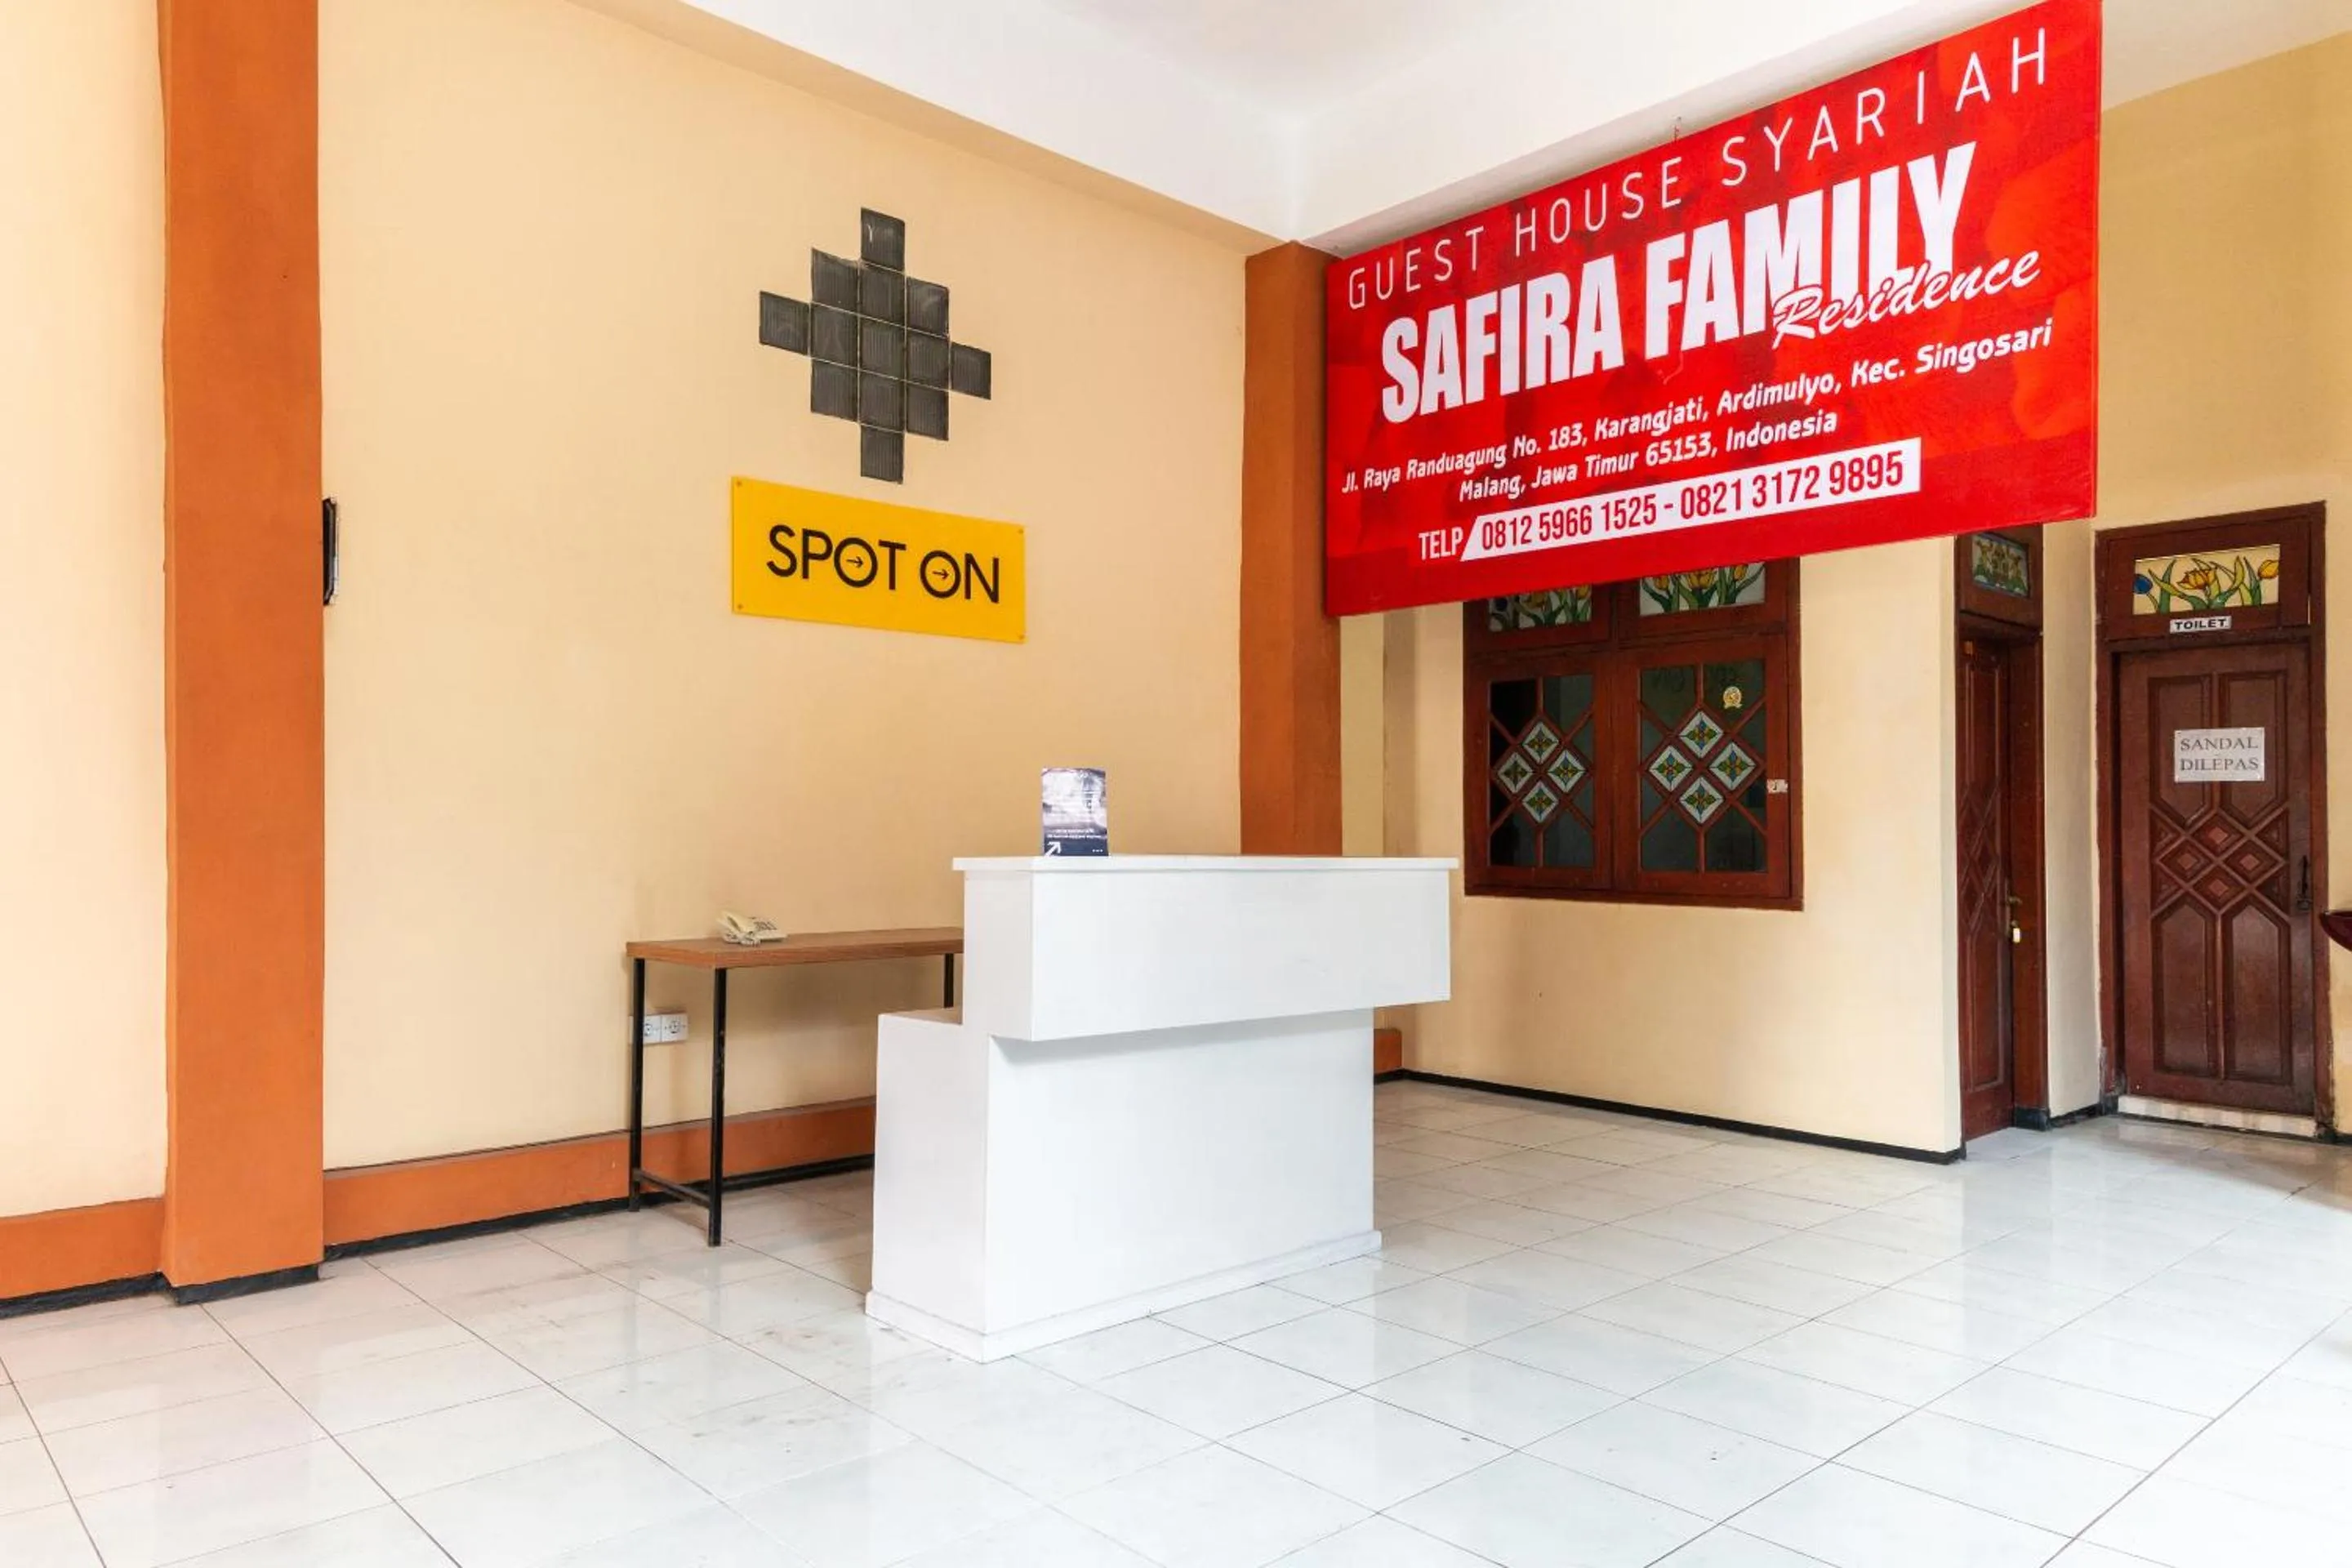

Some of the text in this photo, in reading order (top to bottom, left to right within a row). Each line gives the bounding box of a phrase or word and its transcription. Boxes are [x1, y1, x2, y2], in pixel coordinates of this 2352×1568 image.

[1349, 28, 2046, 310] GUEST HOUSE SYARIAH
[1382, 141, 1976, 424] SAFIRA FAMILY
[1772, 251, 2041, 350] Residence
[1342, 318, 2054, 493] Jl. Raya Randuagung No. 183, Karangjati, Ardimulyo, Kec. Singosari
[1459, 410, 1838, 502] Malang, Jawa Timur 65153, Indonesia
[1419, 527, 1464, 560] TELP
[1481, 515, 1532, 550] 0812
[1539, 505, 1592, 542] 5966
[1601, 493, 1657, 532] 1525
[1680, 479, 1742, 519] 0821
[1752, 465, 1820, 508] 3172
[1829, 450, 1904, 496] 9895
[766, 524, 1000, 604] SPOT ON
[2174, 618, 2227, 630] TOILET
[2180, 737, 2259, 751] SANDAL
[2180, 757, 2260, 772] DILEPAS
